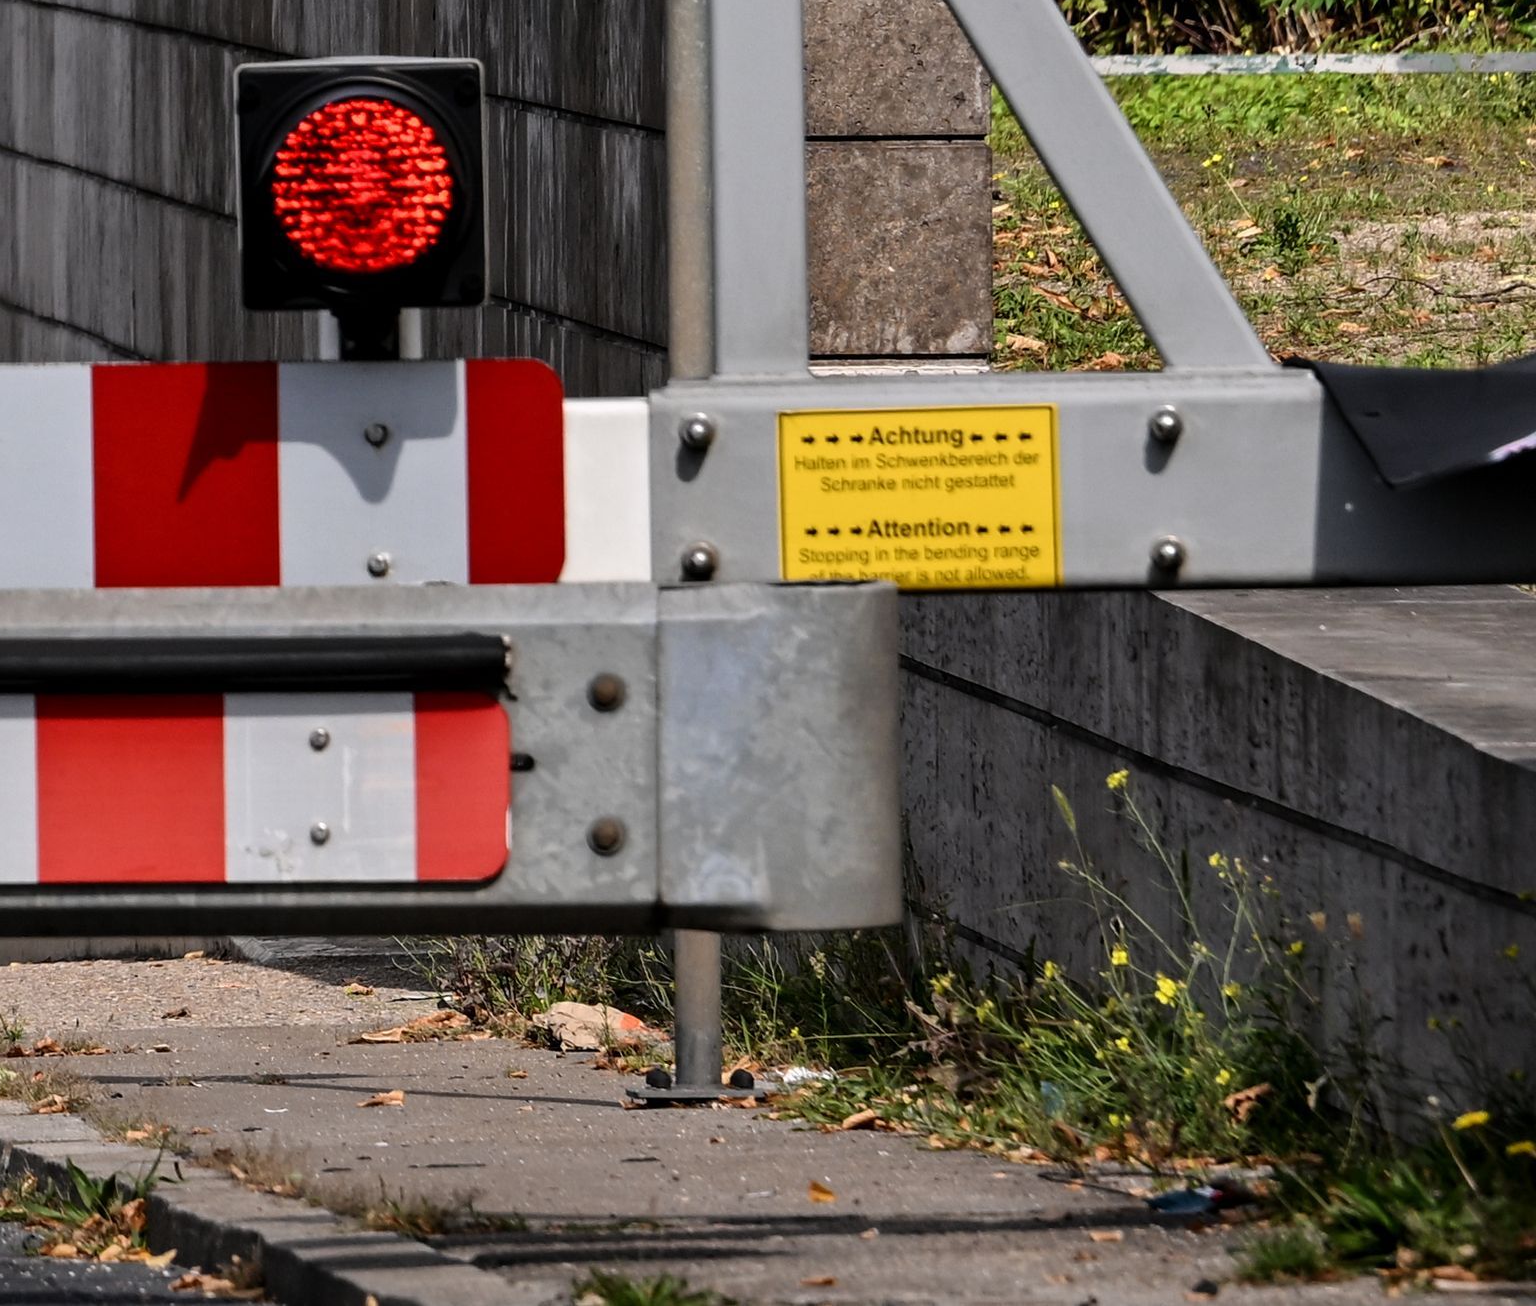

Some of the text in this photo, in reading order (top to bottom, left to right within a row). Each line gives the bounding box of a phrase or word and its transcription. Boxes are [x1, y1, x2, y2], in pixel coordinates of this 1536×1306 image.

[868, 426, 964, 448] Achtung
[795, 451, 1039, 471] Halten im Schwenkbereich der
[820, 473, 1015, 493] Schranke nicht gestattet
[867, 518, 970, 539] Attention
[799, 544, 1040, 565] Stopping in the bending range
[915, 567, 930, 583] is
[935, 567, 960, 583] not
[965, 564, 1031, 582] allowed.
